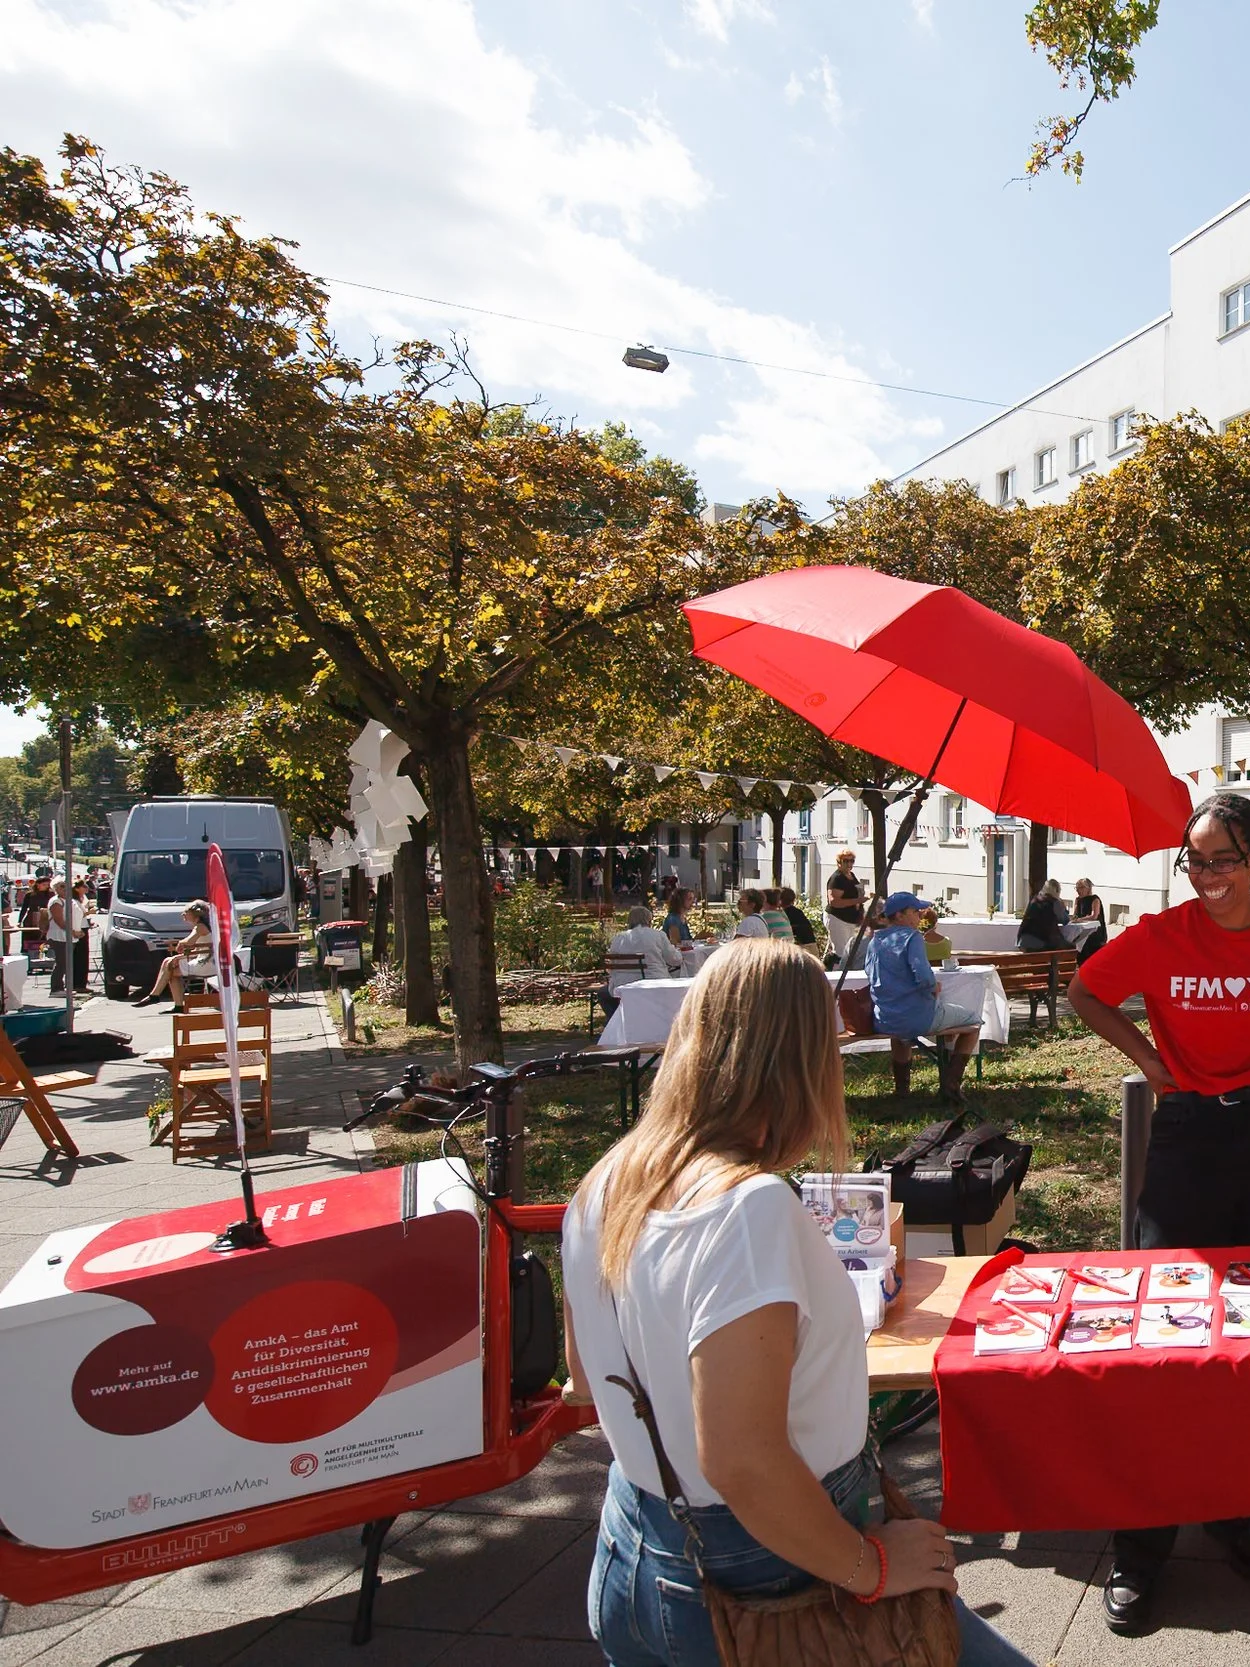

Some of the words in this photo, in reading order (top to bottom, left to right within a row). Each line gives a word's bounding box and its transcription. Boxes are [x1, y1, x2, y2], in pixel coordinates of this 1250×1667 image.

[1170, 976, 1224, 998] FFM
[244, 1334, 287, 1350] AmkA
[304, 1327, 327, 1339] das
[331, 1321, 359, 1335] Amt
[231, 1346, 371, 1380] Antidiskriminierung
[254, 1351, 275, 1362] für
[279, 1337, 349, 1358] Diversität,
[118, 1365, 150, 1377] Mehr
[152, 1360, 173, 1371] auf
[233, 1384, 244, 1394] &
[247, 1361, 368, 1393] gesellschaftlichen
[90, 1370, 200, 1397] www.amka.de
[251, 1376, 352, 1405] Zusammenhalt
[324, 1447, 341, 1456] AMT
[342, 1443, 357, 1452] FÜR
[358, 1429, 424, 1448] MULTIKULTURELLE
[324, 1443, 395, 1464] ANGELEGENHEITEN
[324, 1456, 366, 1472] FRANKFURT
[368, 1454, 379, 1462] AM
[381, 1450, 400, 1459] MAIN
